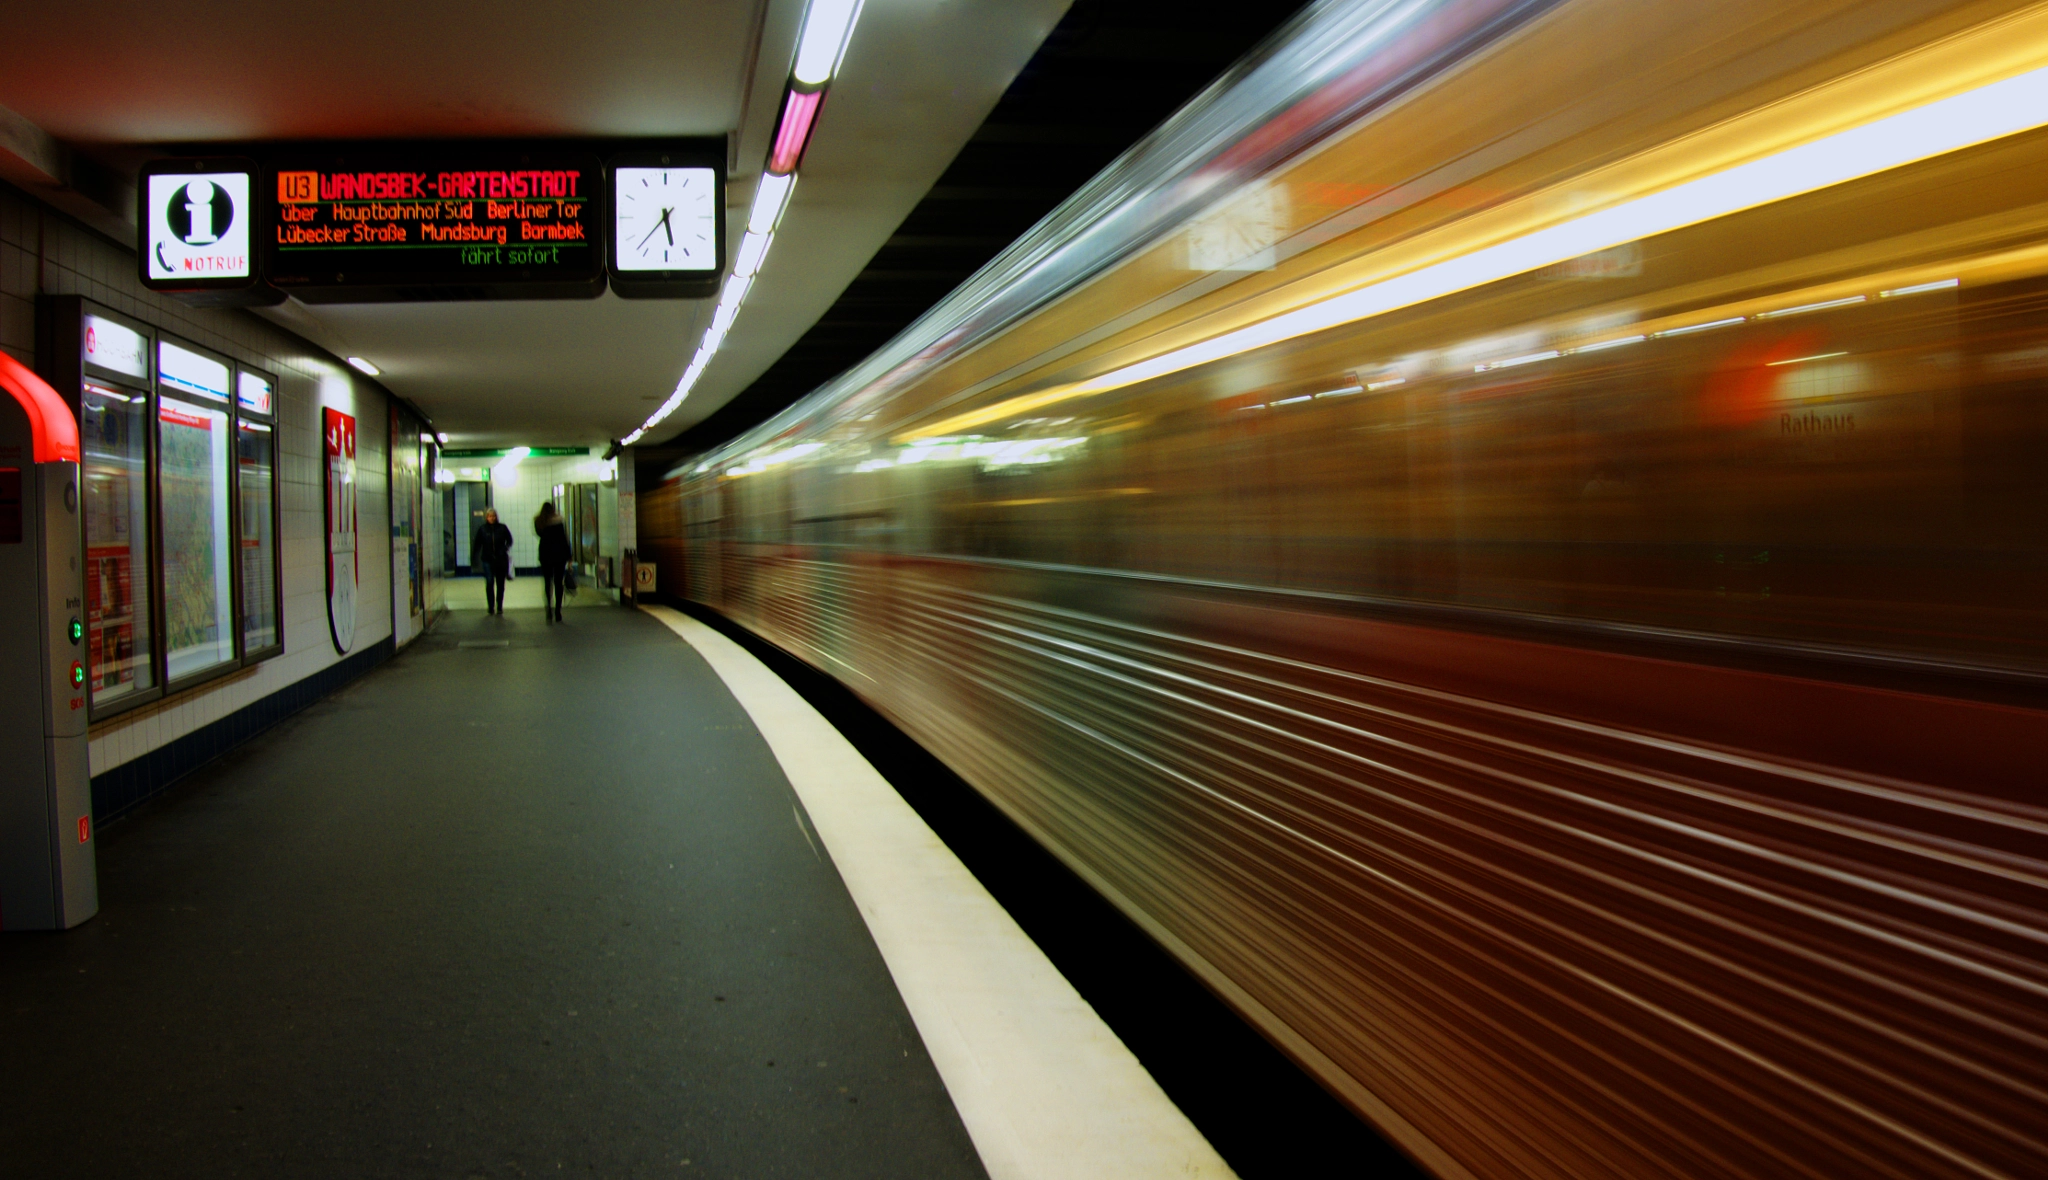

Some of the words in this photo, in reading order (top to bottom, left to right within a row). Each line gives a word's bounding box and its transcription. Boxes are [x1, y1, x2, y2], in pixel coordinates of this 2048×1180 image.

[286, 175, 311, 199] U3
[320, 171, 580, 200] WANDSBEK-GARTENSTADT
[281, 203, 318, 222] über
[332, 201, 442, 225] Hauptbahnhof
[444, 201, 473, 220] Süd
[487, 199, 552, 219] Berliner
[556, 199, 582, 219] Tor
[277, 224, 350, 243] Lübecker
[353, 223, 407, 243] Straße
[421, 221, 507, 245] Mundsburg
[521, 221, 585, 240] Barmbek
[184, 255, 246, 271] NOTRUF
[461, 246, 502, 265] fährt
[508, 245, 559, 264] sofort
[1780, 410, 1855, 434] Rathaus
[66, 598, 80, 610] Info
[70, 697, 84, 710] SOS
